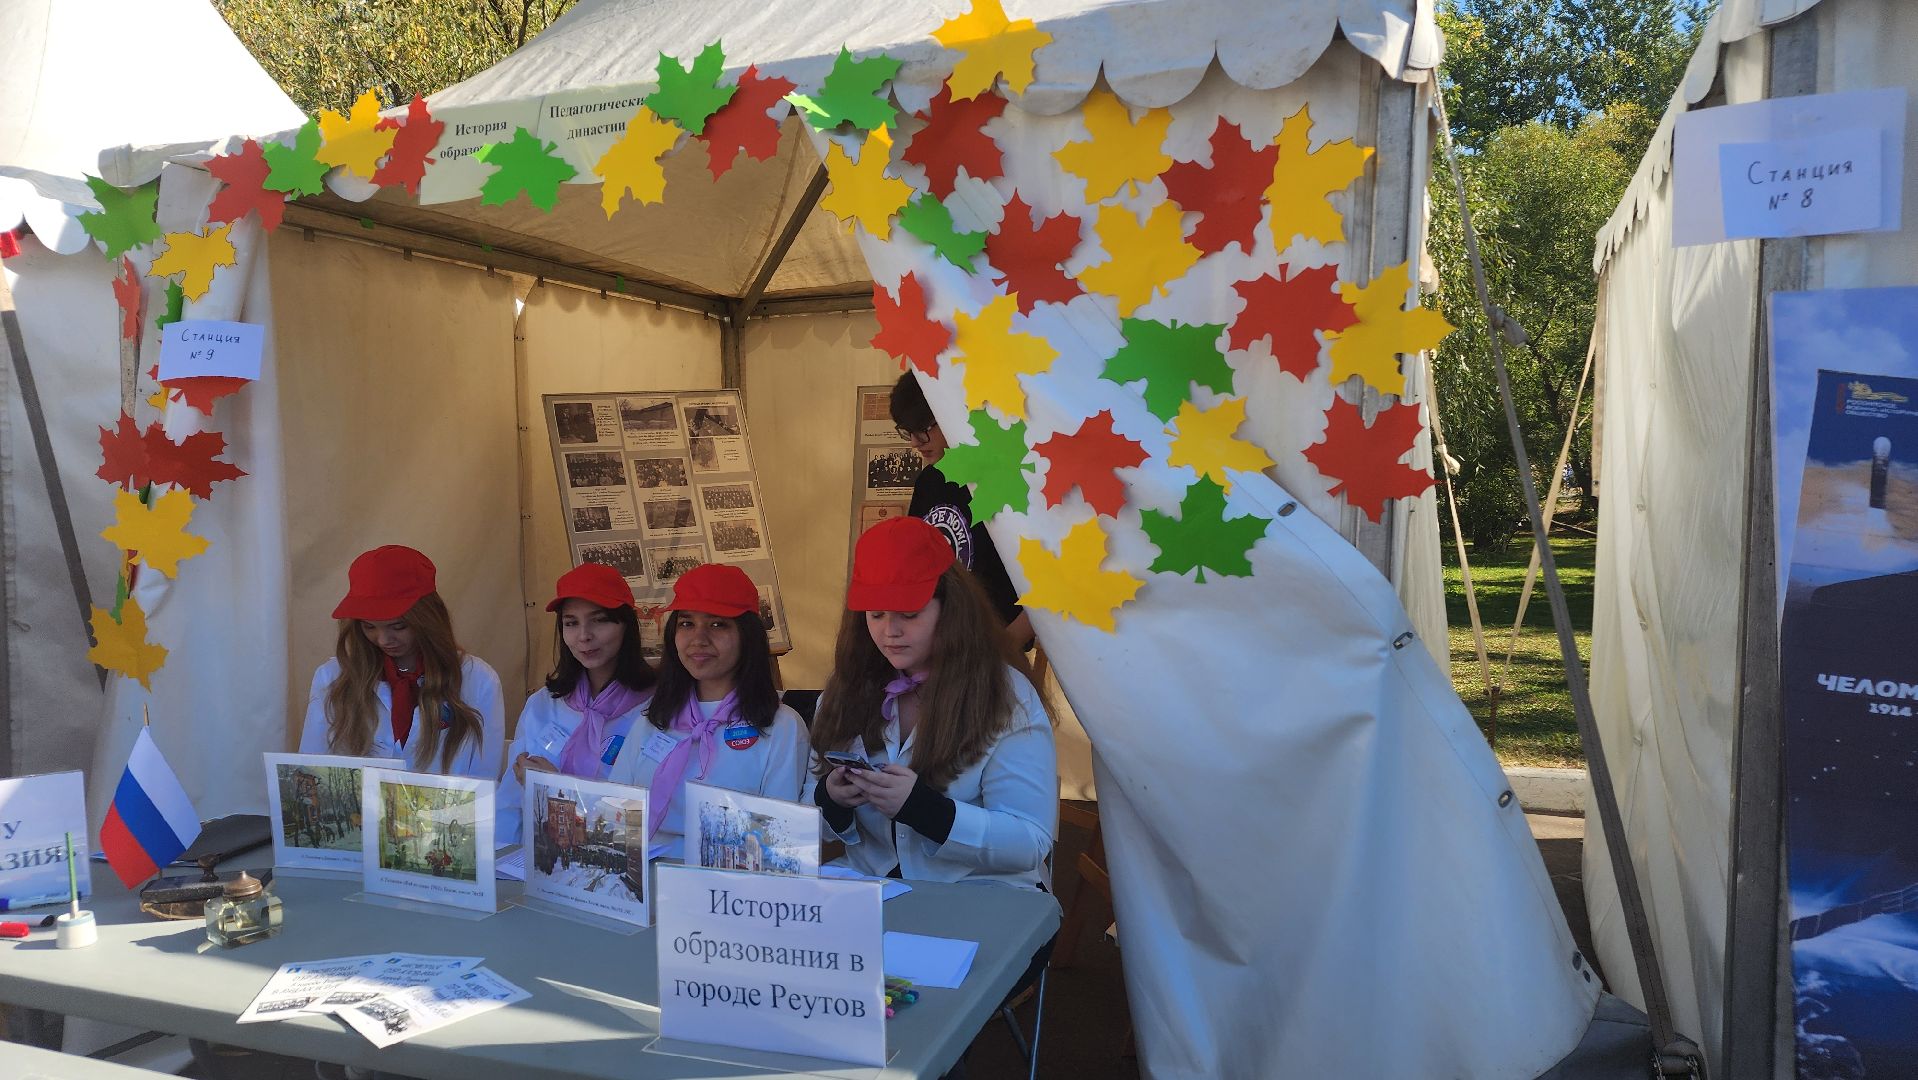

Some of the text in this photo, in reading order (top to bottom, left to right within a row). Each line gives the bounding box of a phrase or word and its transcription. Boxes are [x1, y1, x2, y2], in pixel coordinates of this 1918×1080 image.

[549, 96, 645, 119] Педагогически
[455, 120, 508, 137] История
[566, 121, 627, 141] династии
[440, 145, 485, 161] образо
[1800, 187, 1814, 208] 8
[206, 348, 215, 361] 9
[1867, 702, 1913, 717] 1914
[707, 888, 825, 928] История
[673, 930, 865, 973] образования в
[674, 978, 867, 1019] городе Реутов
